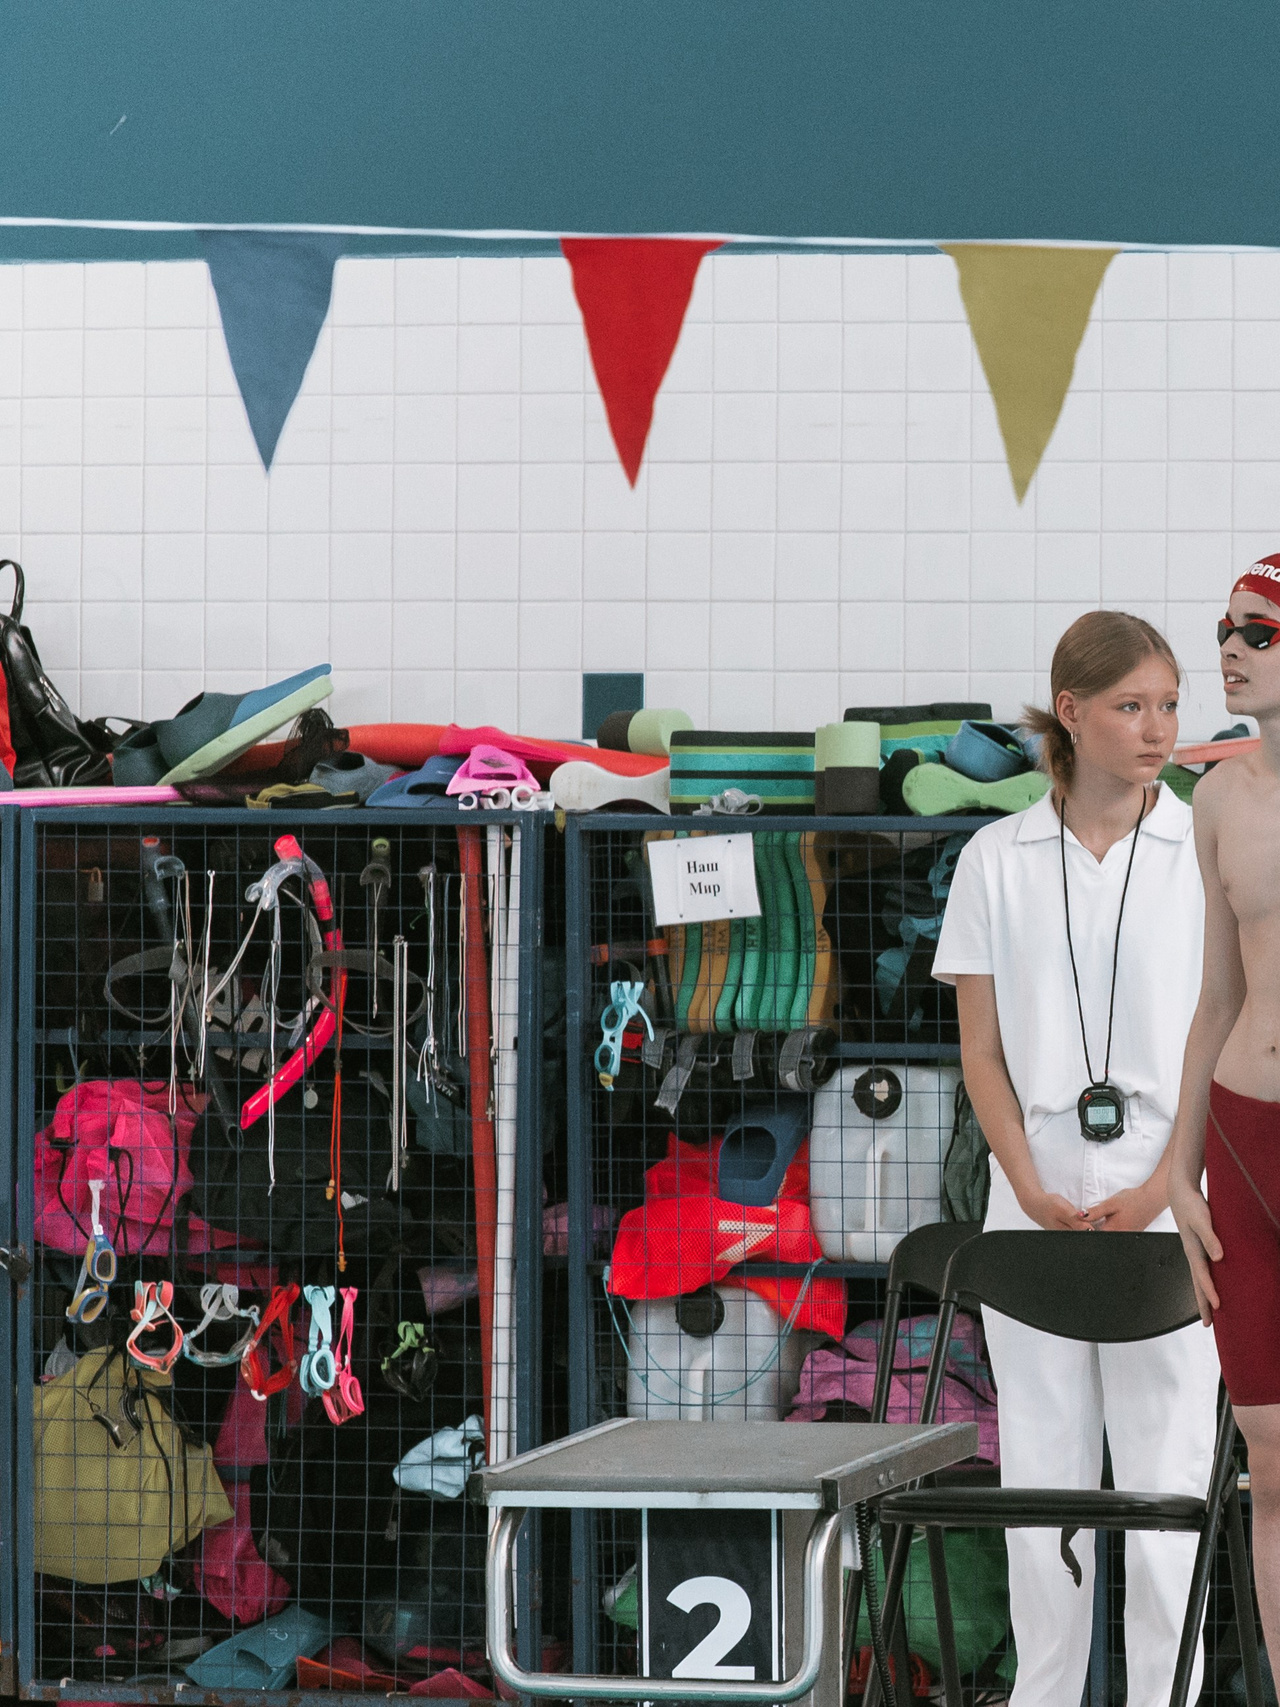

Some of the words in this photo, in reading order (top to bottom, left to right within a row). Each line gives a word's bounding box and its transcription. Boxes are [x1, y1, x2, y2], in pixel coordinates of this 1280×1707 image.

[686, 860, 719, 874] Наш
[689, 881, 721, 897] Мир
[666, 1575, 755, 1680] 2
